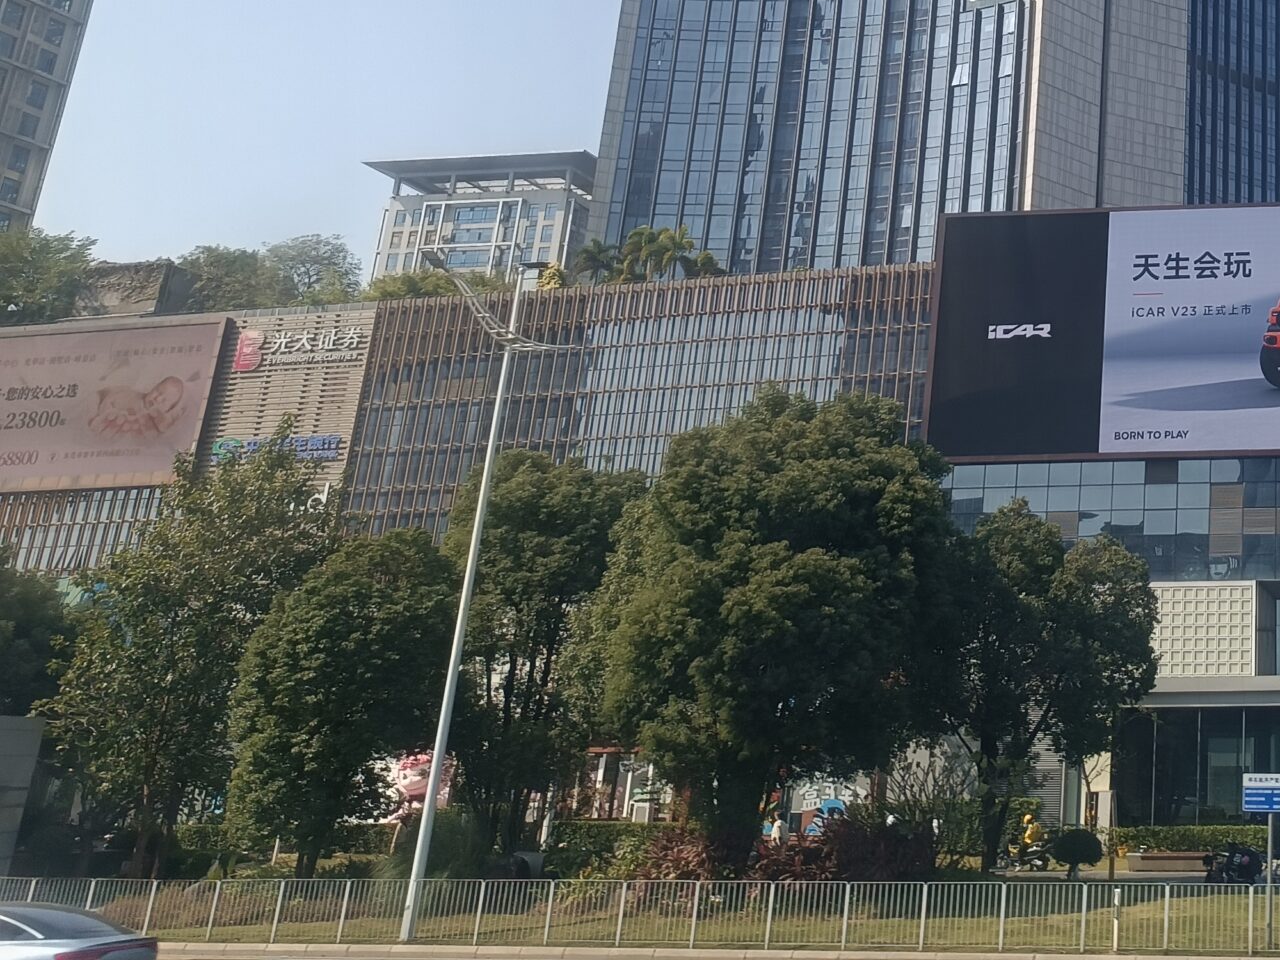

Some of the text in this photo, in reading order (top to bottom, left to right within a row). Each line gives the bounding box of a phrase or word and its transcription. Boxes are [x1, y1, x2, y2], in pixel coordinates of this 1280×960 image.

[1132, 250, 1252, 281] 天生会玩
[1131, 303, 1252, 318] iCAR V23 正式上市
[270, 326, 362, 352] 光大证券
[1114, 430, 1189, 440] BORN TO PLAY
